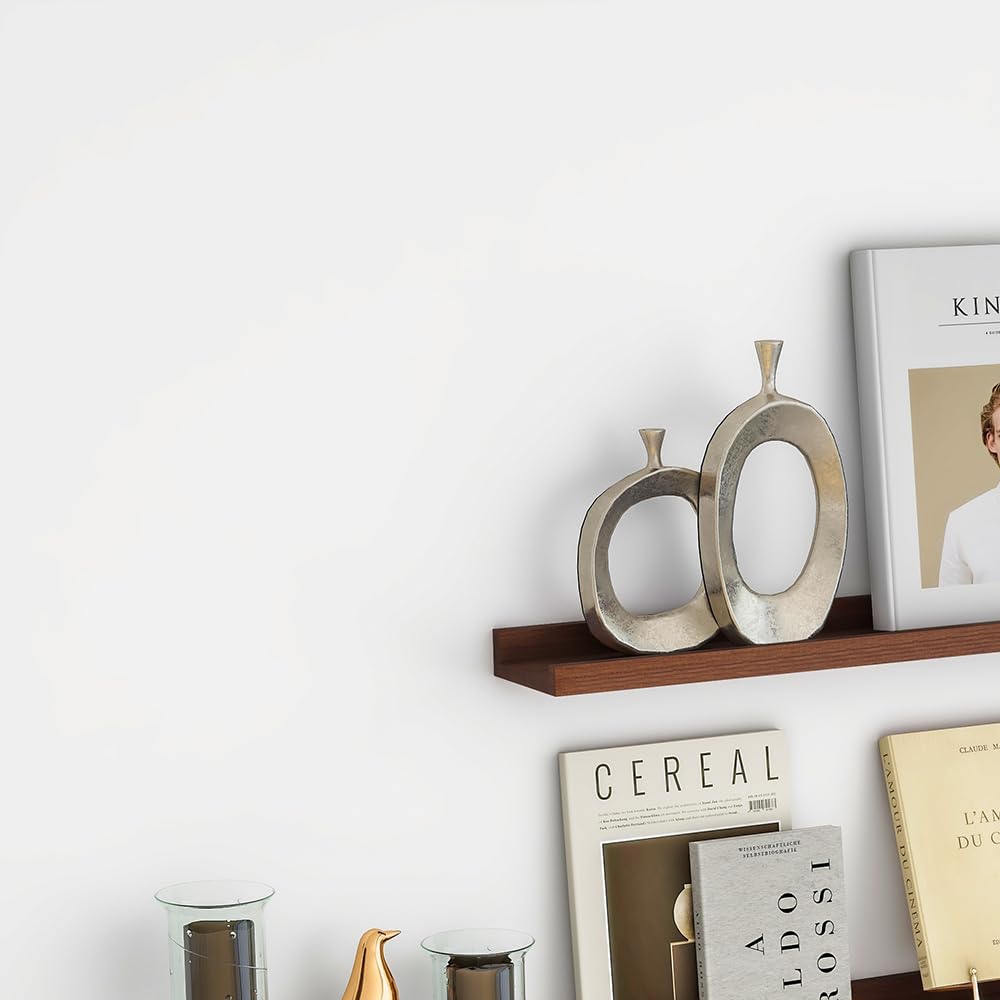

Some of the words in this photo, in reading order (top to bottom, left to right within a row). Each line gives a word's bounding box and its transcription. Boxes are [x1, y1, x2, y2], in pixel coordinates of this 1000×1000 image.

[959, 744, 988, 753] CLAUDE
[595, 746, 779, 800] CEREAL
[738, 840, 801, 852] WISSENSCHAFTLICHE
[957, 834, 983, 849] DU
[743, 848, 797, 858] SELBSTBIOGRAFIE
[900, 845, 909, 870] DU
[745, 933, 764, 955] A
